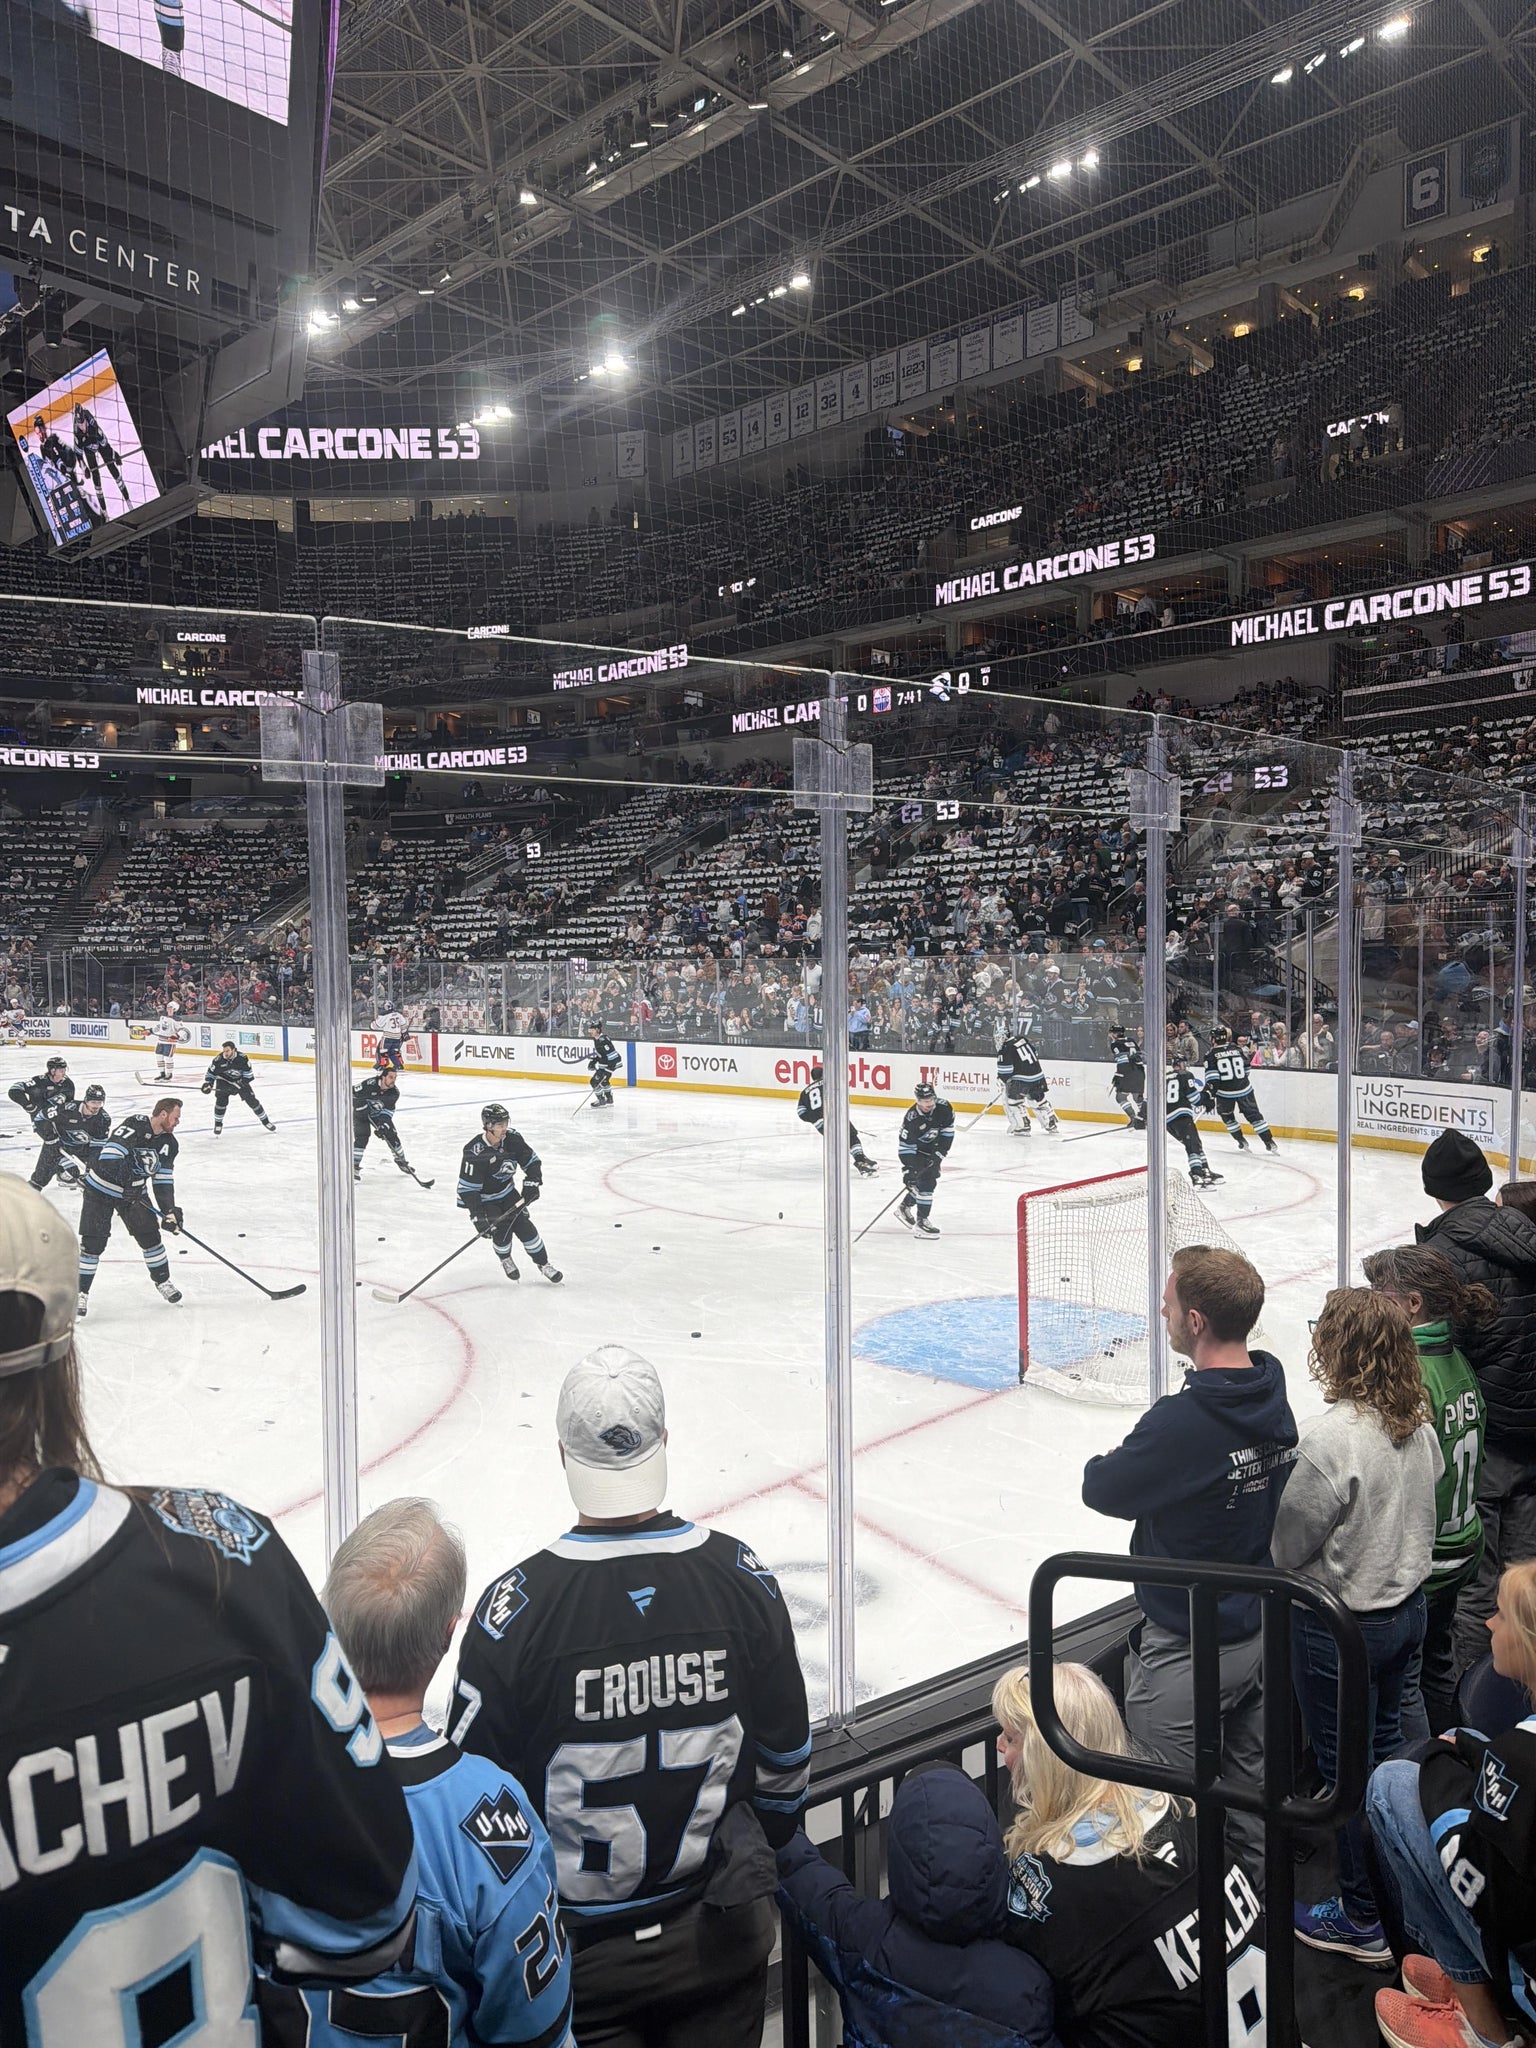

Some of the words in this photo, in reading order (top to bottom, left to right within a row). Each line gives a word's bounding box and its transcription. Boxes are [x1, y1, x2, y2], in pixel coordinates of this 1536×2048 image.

[1412, 167, 1440, 210] 6
[4, 204, 52, 244] TA
[69, 229, 201, 294] CENTER
[901, 360, 926, 379] 1223
[820, 392, 838, 411] 32
[852, 383, 860, 399] 4
[796, 402, 809, 420] 12
[257, 427, 433, 460] CARCONE
[438, 427, 480, 460] 53
[935, 570, 1000, 607] MICHAEL
[1003, 541, 1121, 591] CARCONE
[1124, 533, 1166, 565] 53
[1231, 608, 1319, 647] MICHAEL
[1323, 575, 1483, 631] CARCONE
[1488, 565, 1531, 601] 53
[177, 632, 227, 643] CARCONE
[552, 667, 595, 691] MICHAEL
[598, 649, 669, 683] CARCONE
[958, 672, 970, 695] 0
[137, 687, 198, 706] MICHAEL
[857, 694, 868, 712] 0
[896, 689, 922, 705] 7:41
[732, 707, 782, 734] MICHAEL
[73, 751, 100, 769] 53
[374, 753, 425, 771] MICHAEL
[427, 748, 506, 769] CARCONE
[508, 746, 528, 763] 53
[1254, 765, 1288, 789] 53
[936, 800, 960, 821] 53
[526, 843, 541, 859] 53
[71, 1023, 87, 1035] BUD
[88, 1024, 108, 1037] LIGHT
[465, 1045, 515, 1060] FILEVINE
[682, 1056, 738, 1073] TOYOTA
[1217, 1056, 1246, 1081] 98
[943, 1071, 990, 1085] HEALTH
[1362, 1083, 1404, 1098] JUST
[1363, 1099, 1487, 1127] INGREDIENTS
[114, 1125, 136, 1139] 67
[159, 1144, 170, 1157] A
[464, 1161, 474, 1176] 11
[1227, 1461, 1262, 1480] BETTER
[492, 1575, 517, 1625] UTAH
[574, 1650, 729, 1722] CROUSE
[1485, 1761, 1507, 1809] UTAH
[545, 1713, 745, 1901] 67
[475, 1809, 529, 1838] UTAH
